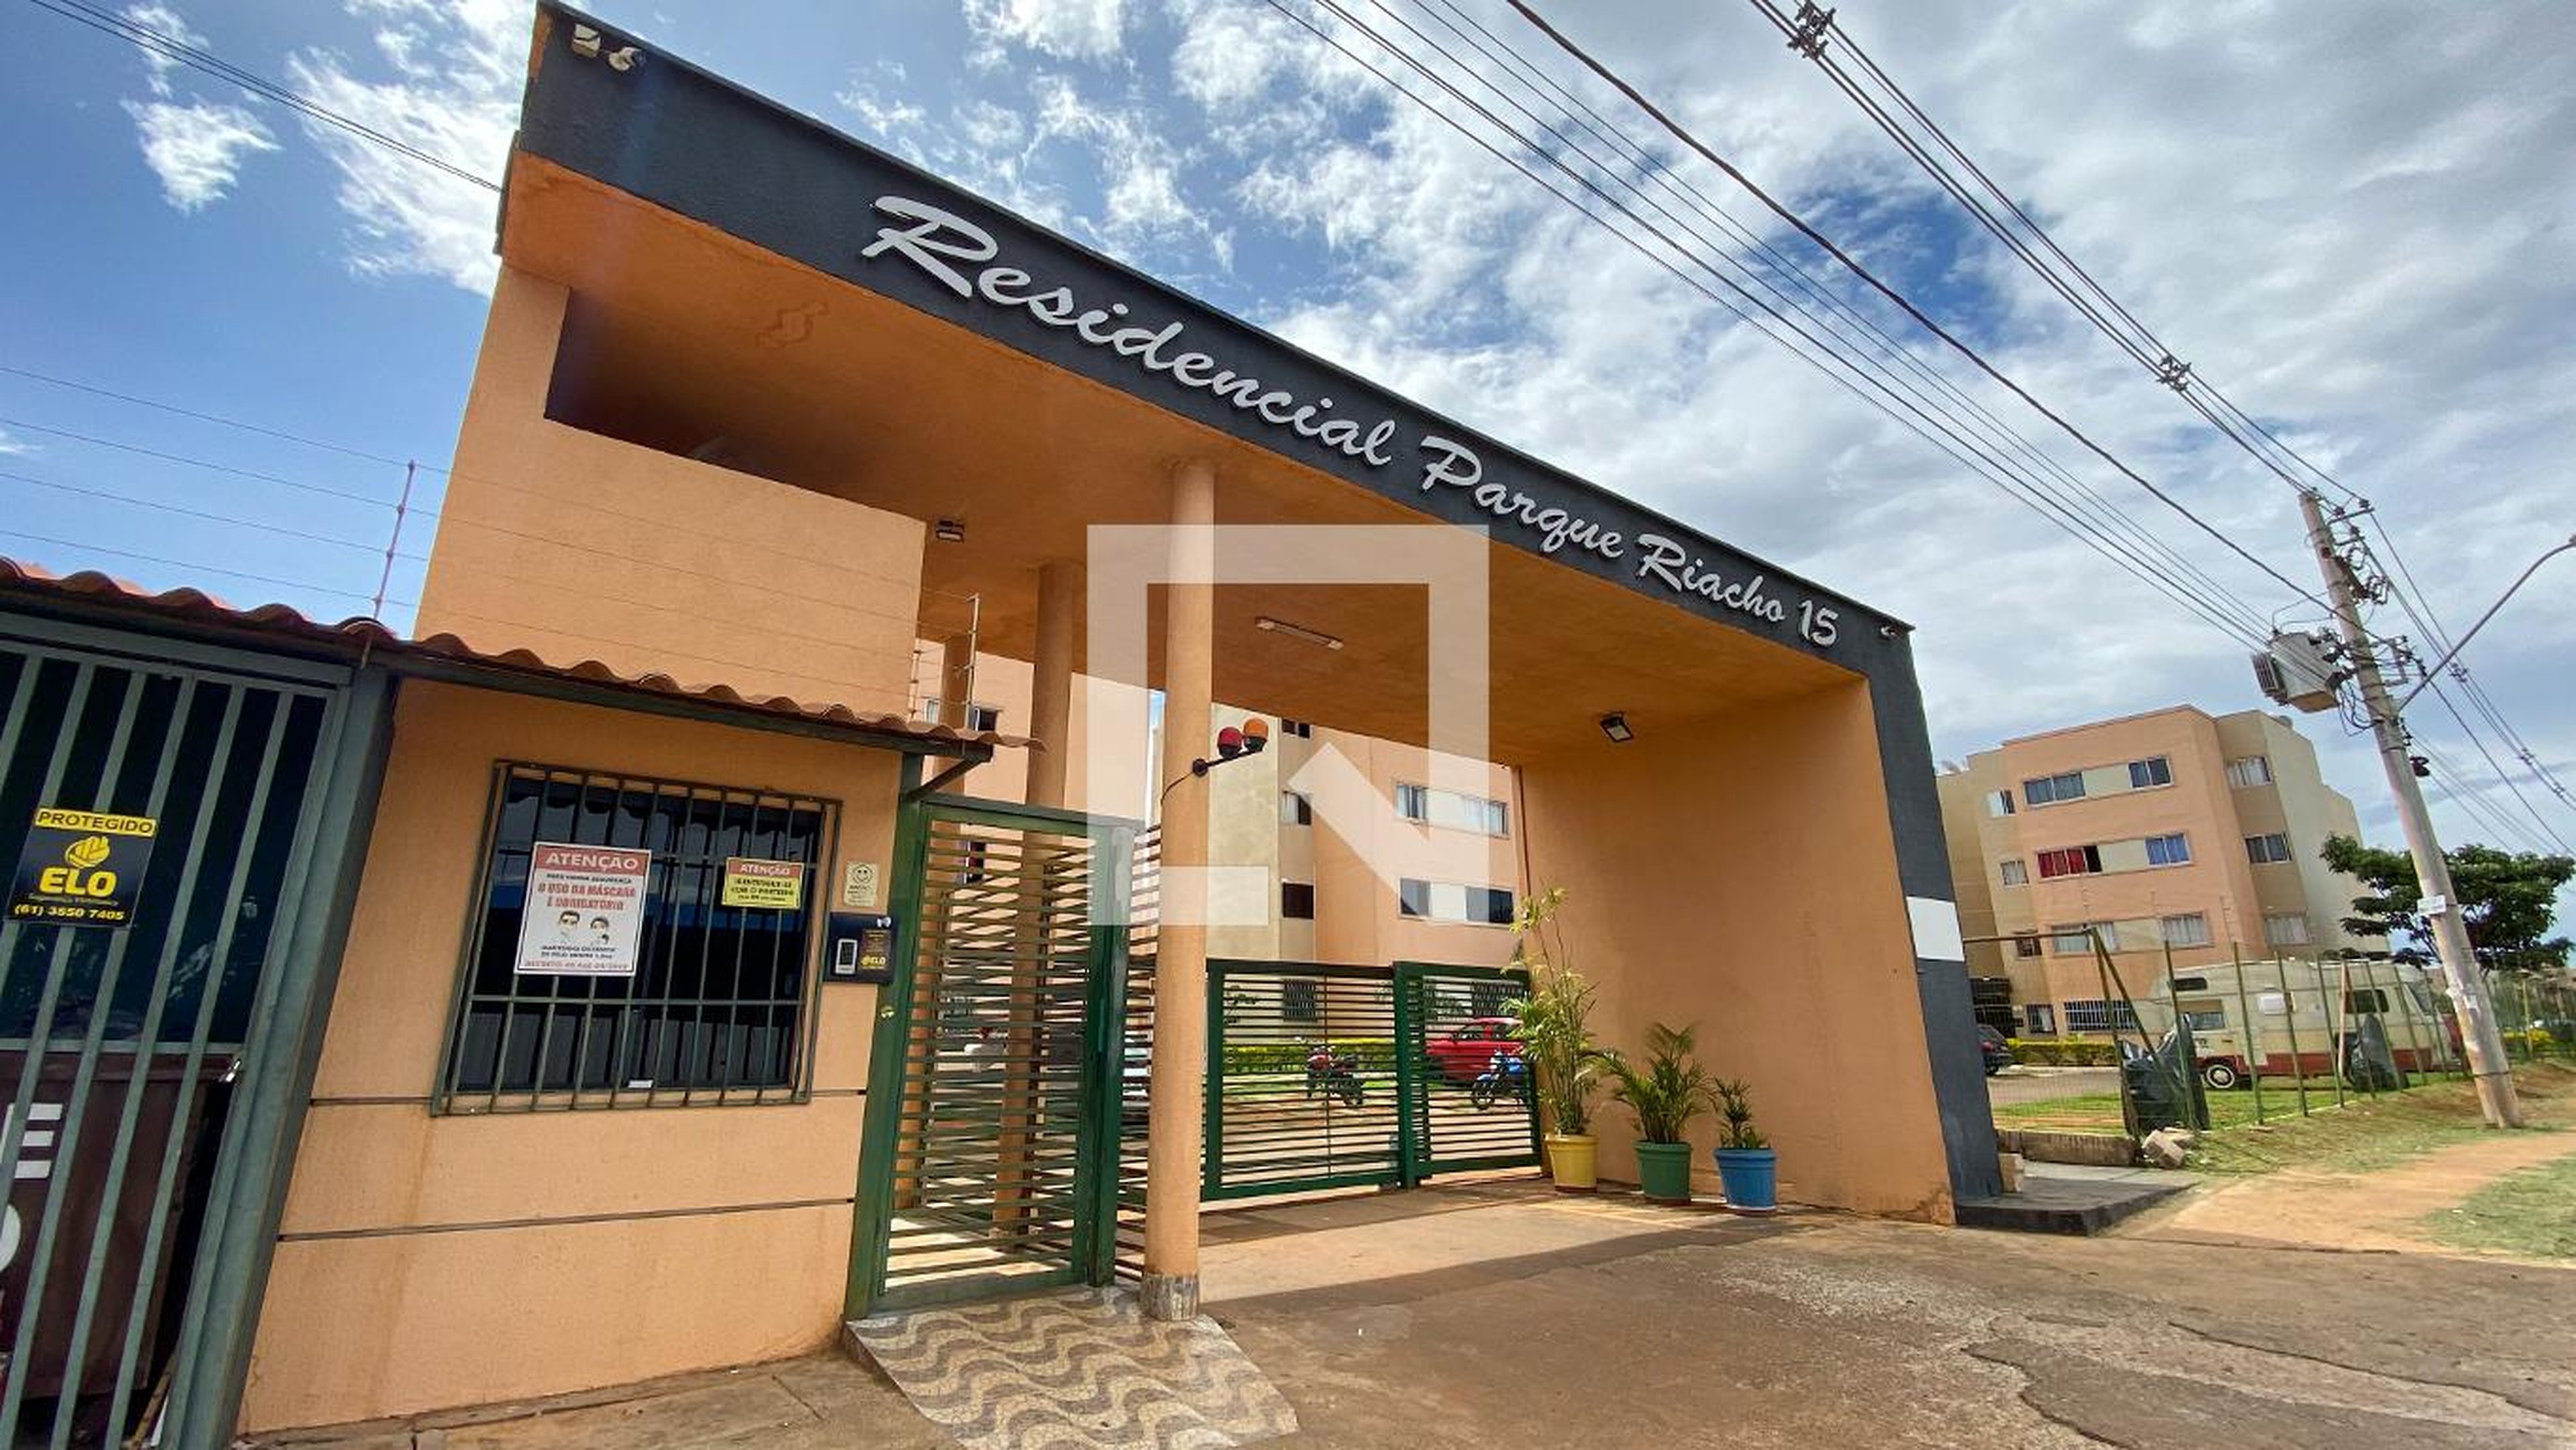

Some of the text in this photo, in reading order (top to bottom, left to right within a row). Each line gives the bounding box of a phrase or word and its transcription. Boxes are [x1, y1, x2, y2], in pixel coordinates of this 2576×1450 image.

[861, 195, 1839, 648] Residencial Parque Riacho 15
[38, 811, 153, 833] PROTEGIDO
[39, 867, 117, 898] ELO
[14, 904, 44, 917] (61)
[89, 909, 125, 921] 7405
